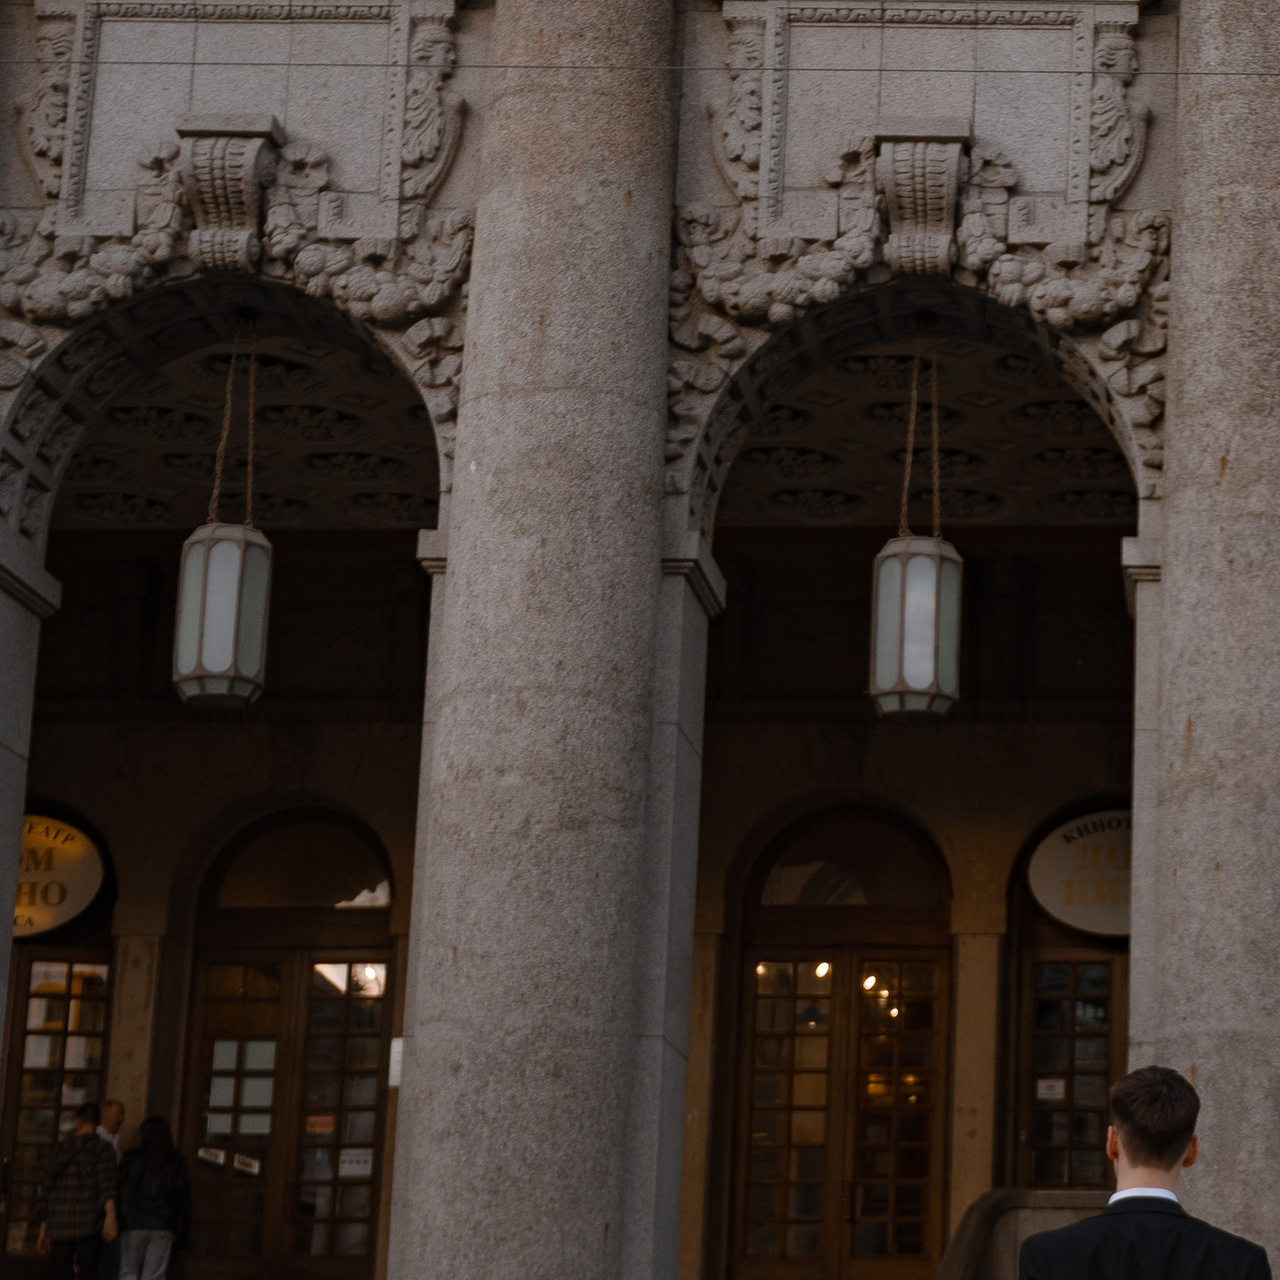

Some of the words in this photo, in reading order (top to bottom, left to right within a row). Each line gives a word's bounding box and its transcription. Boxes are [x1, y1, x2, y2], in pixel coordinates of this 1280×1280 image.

[27, 822, 75, 844] ЕАТР
[1062, 817, 1131, 843] КИНО
[19, 846, 55, 873] М
[1064, 879, 1131, 906] КИ
